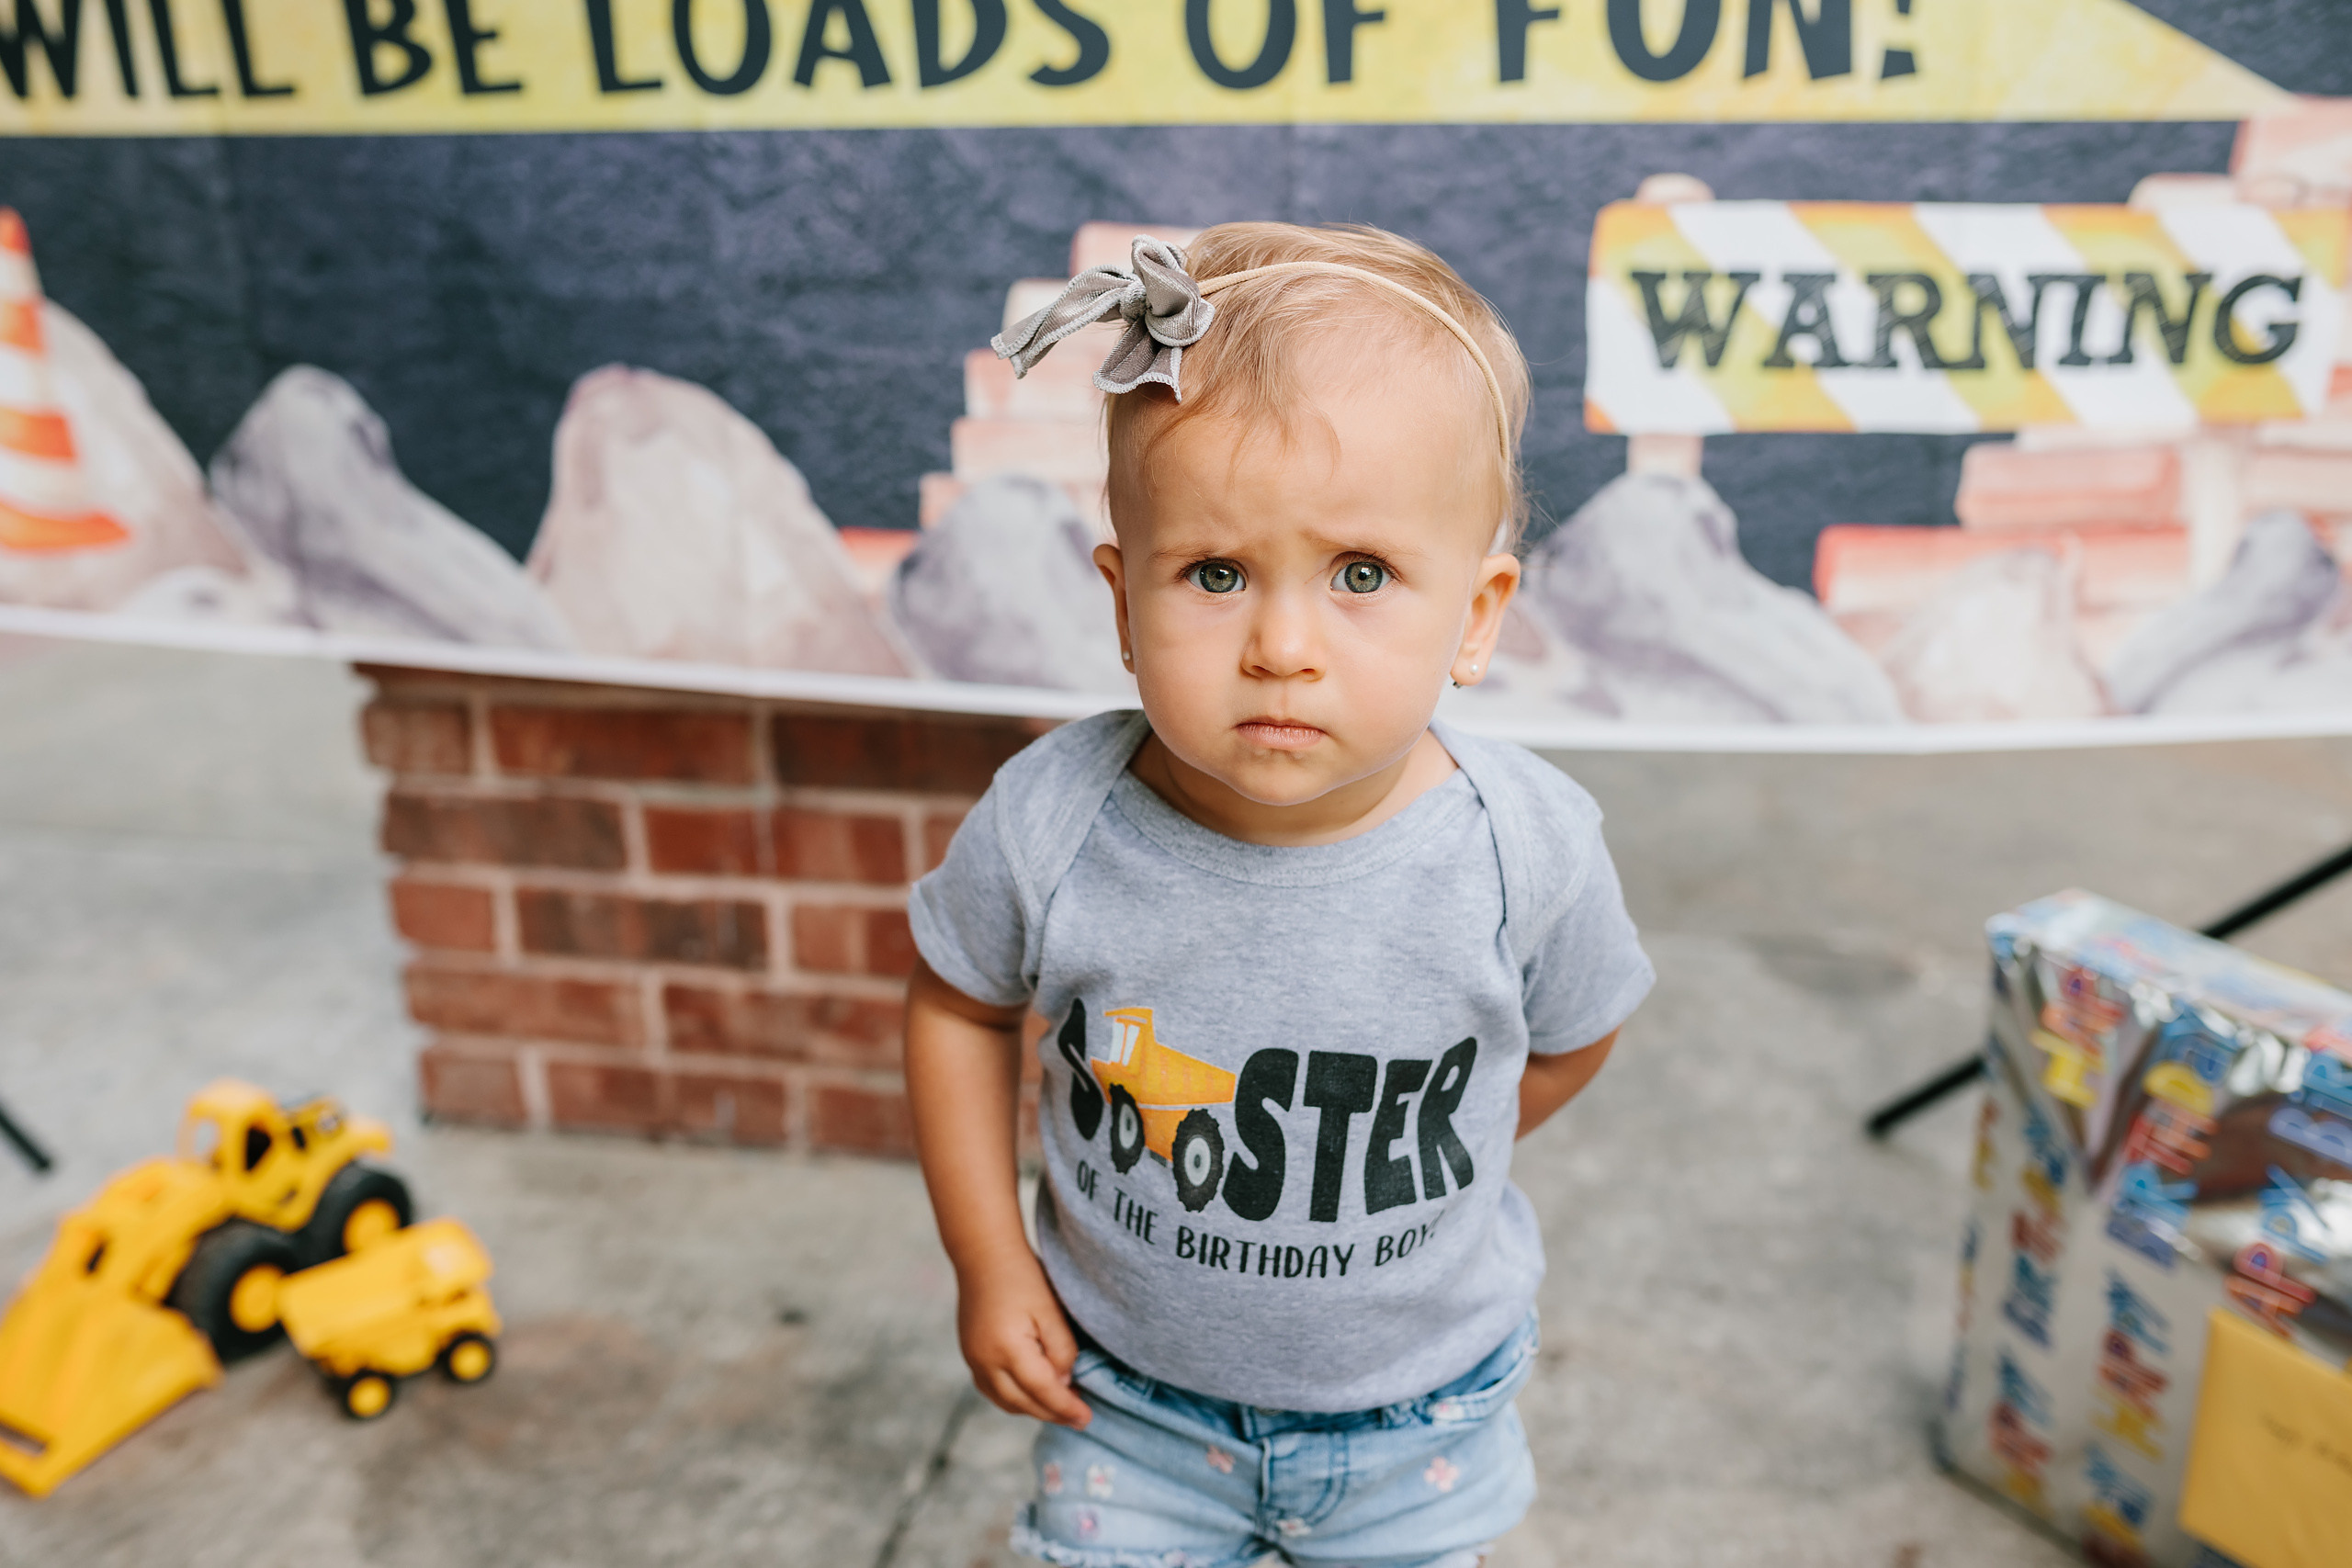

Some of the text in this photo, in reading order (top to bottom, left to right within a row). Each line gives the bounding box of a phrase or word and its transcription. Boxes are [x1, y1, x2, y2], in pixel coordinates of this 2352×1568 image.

[0, 0, 297, 98] WILL
[344, 0, 524, 96] BE
[584, 0, 1110, 93] LOADS
[1184, 0, 1385, 89] OF
[1628, 270, 2303, 369] WARNING
[1077, 1159, 1102, 1201] OF
[1113, 1186, 1158, 1246] THE
[1176, 1225, 1355, 1279] BIRTHDAY
